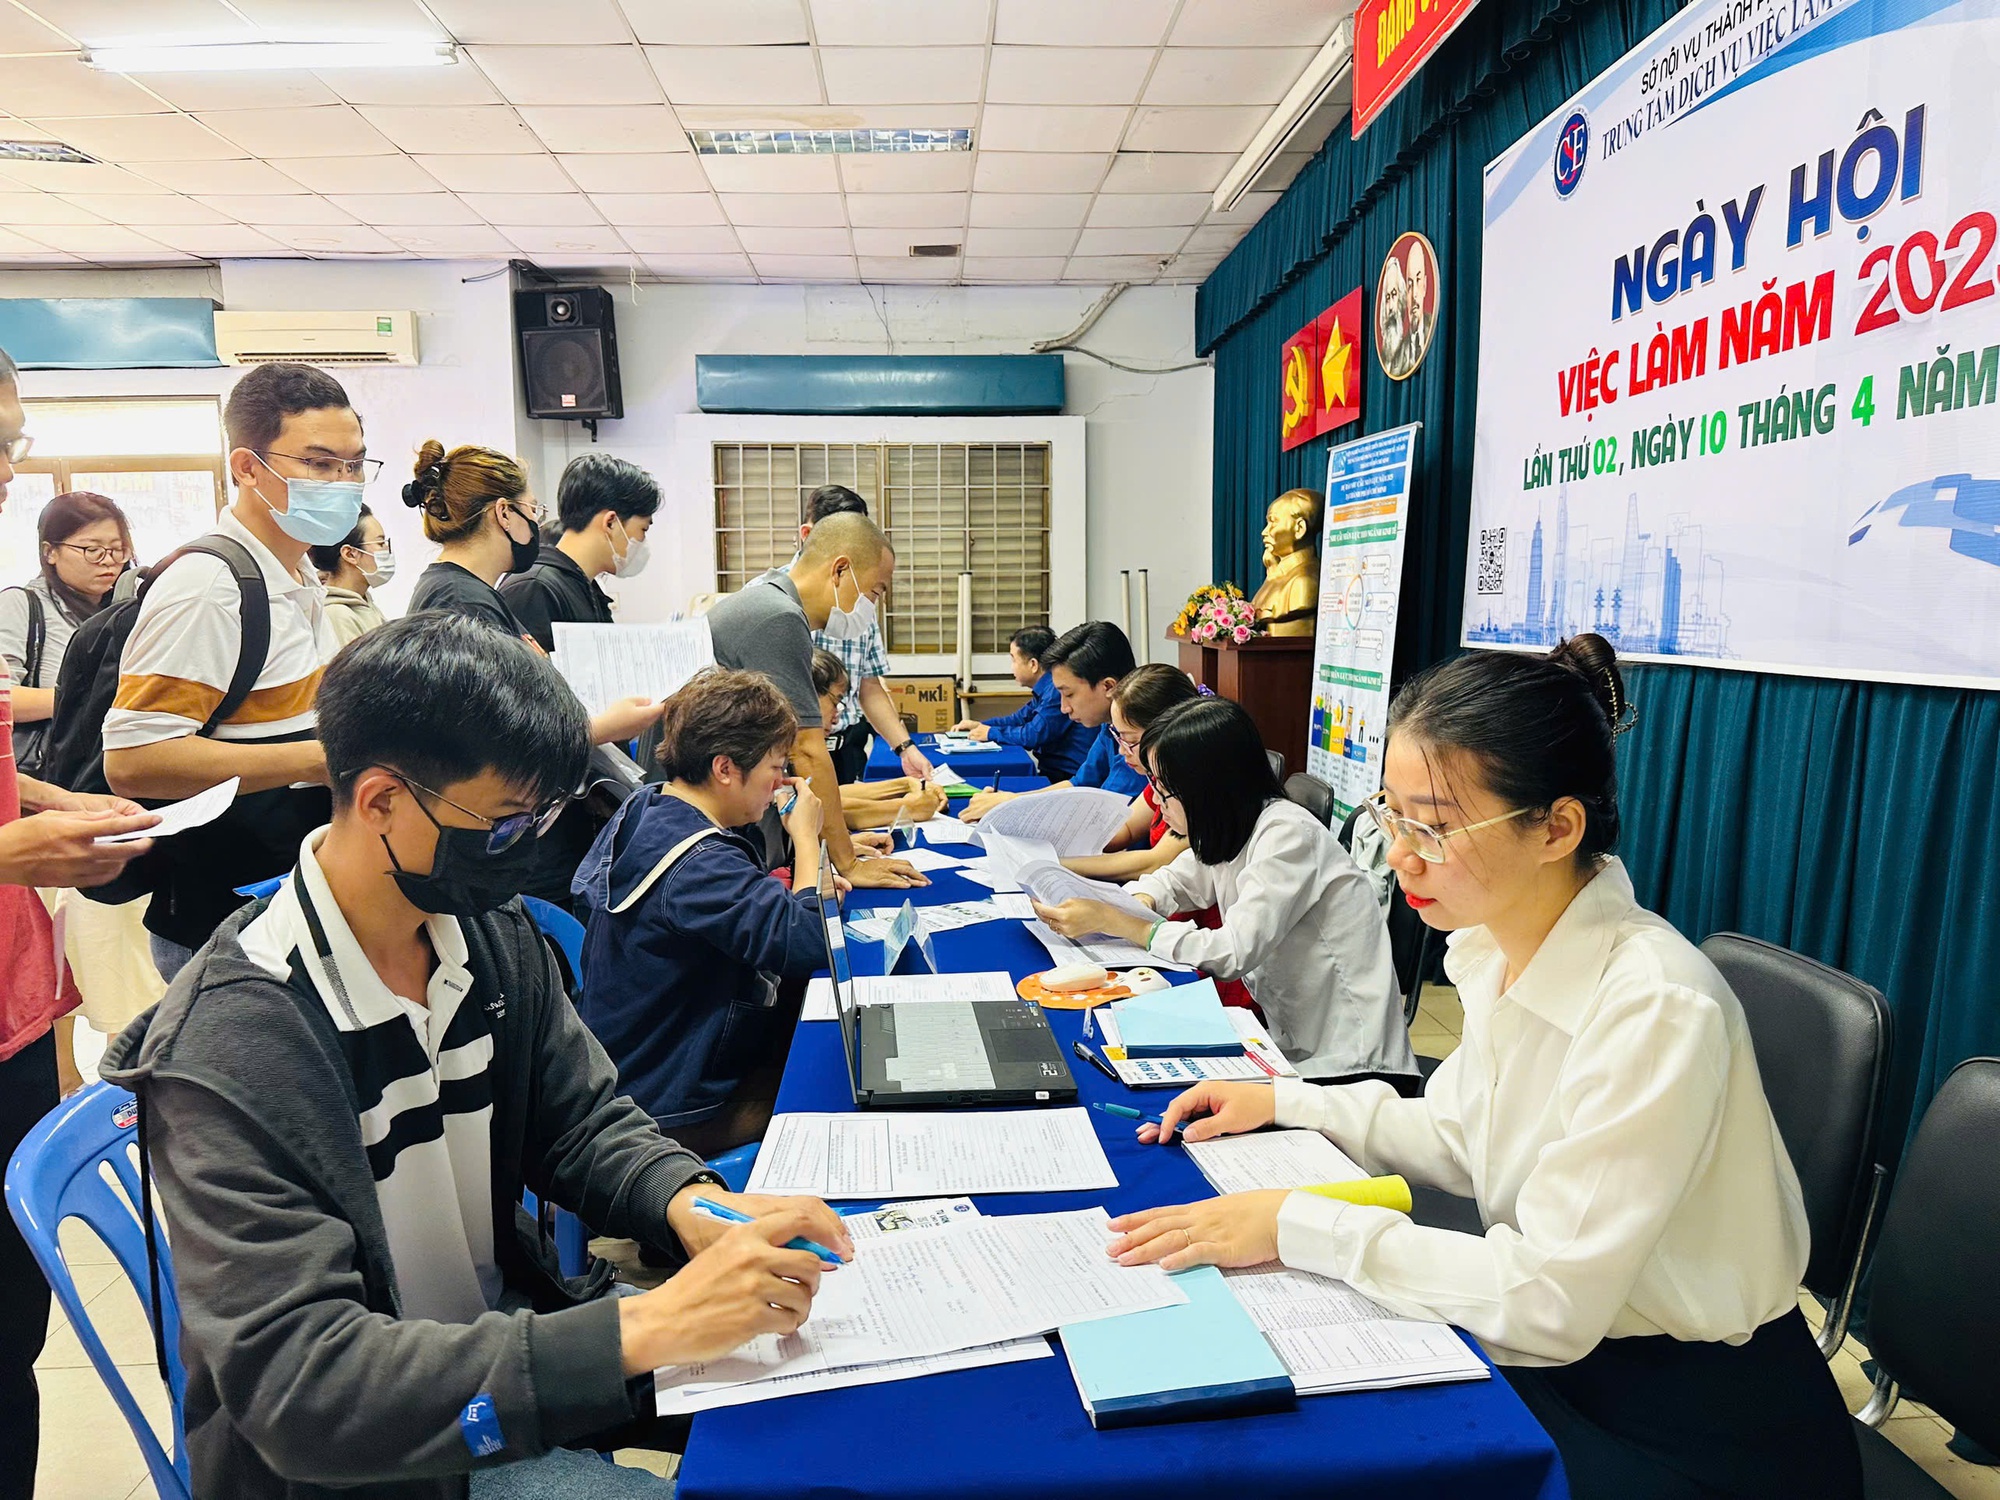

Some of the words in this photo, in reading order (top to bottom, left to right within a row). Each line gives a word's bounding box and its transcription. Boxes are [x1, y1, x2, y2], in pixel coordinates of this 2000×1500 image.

[1602, 109, 1643, 160] TRUNG
[1646, 85, 1675, 132] TÂM
[1678, 61, 1716, 110] DỊCH
[1721, 38, 1744, 80] VỤ
[1747, 6, 1787, 62] VIỆC
[1683, 32, 1701, 62] VỤ
[1611, 183, 1766, 323] NGÀY
[1786, 103, 1926, 248] HỘI
[1558, 347, 1619, 422] VIỆC
[1629, 321, 1709, 398] LÀM
[1719, 269, 1835, 370] NĂM
[1854, 211, 2000, 336] 202
[1523, 443, 1553, 490] LẦN
[1558, 435, 1590, 484] THỨ
[1630, 413, 1695, 470] NGÀY
[1699, 410, 1727, 456] 10
[1738, 383, 1836, 449] THÁNG
[1851, 375, 1876, 427] 4
[1896, 343, 2000, 421] NĂM
[919, 684, 942, 702] MK1
